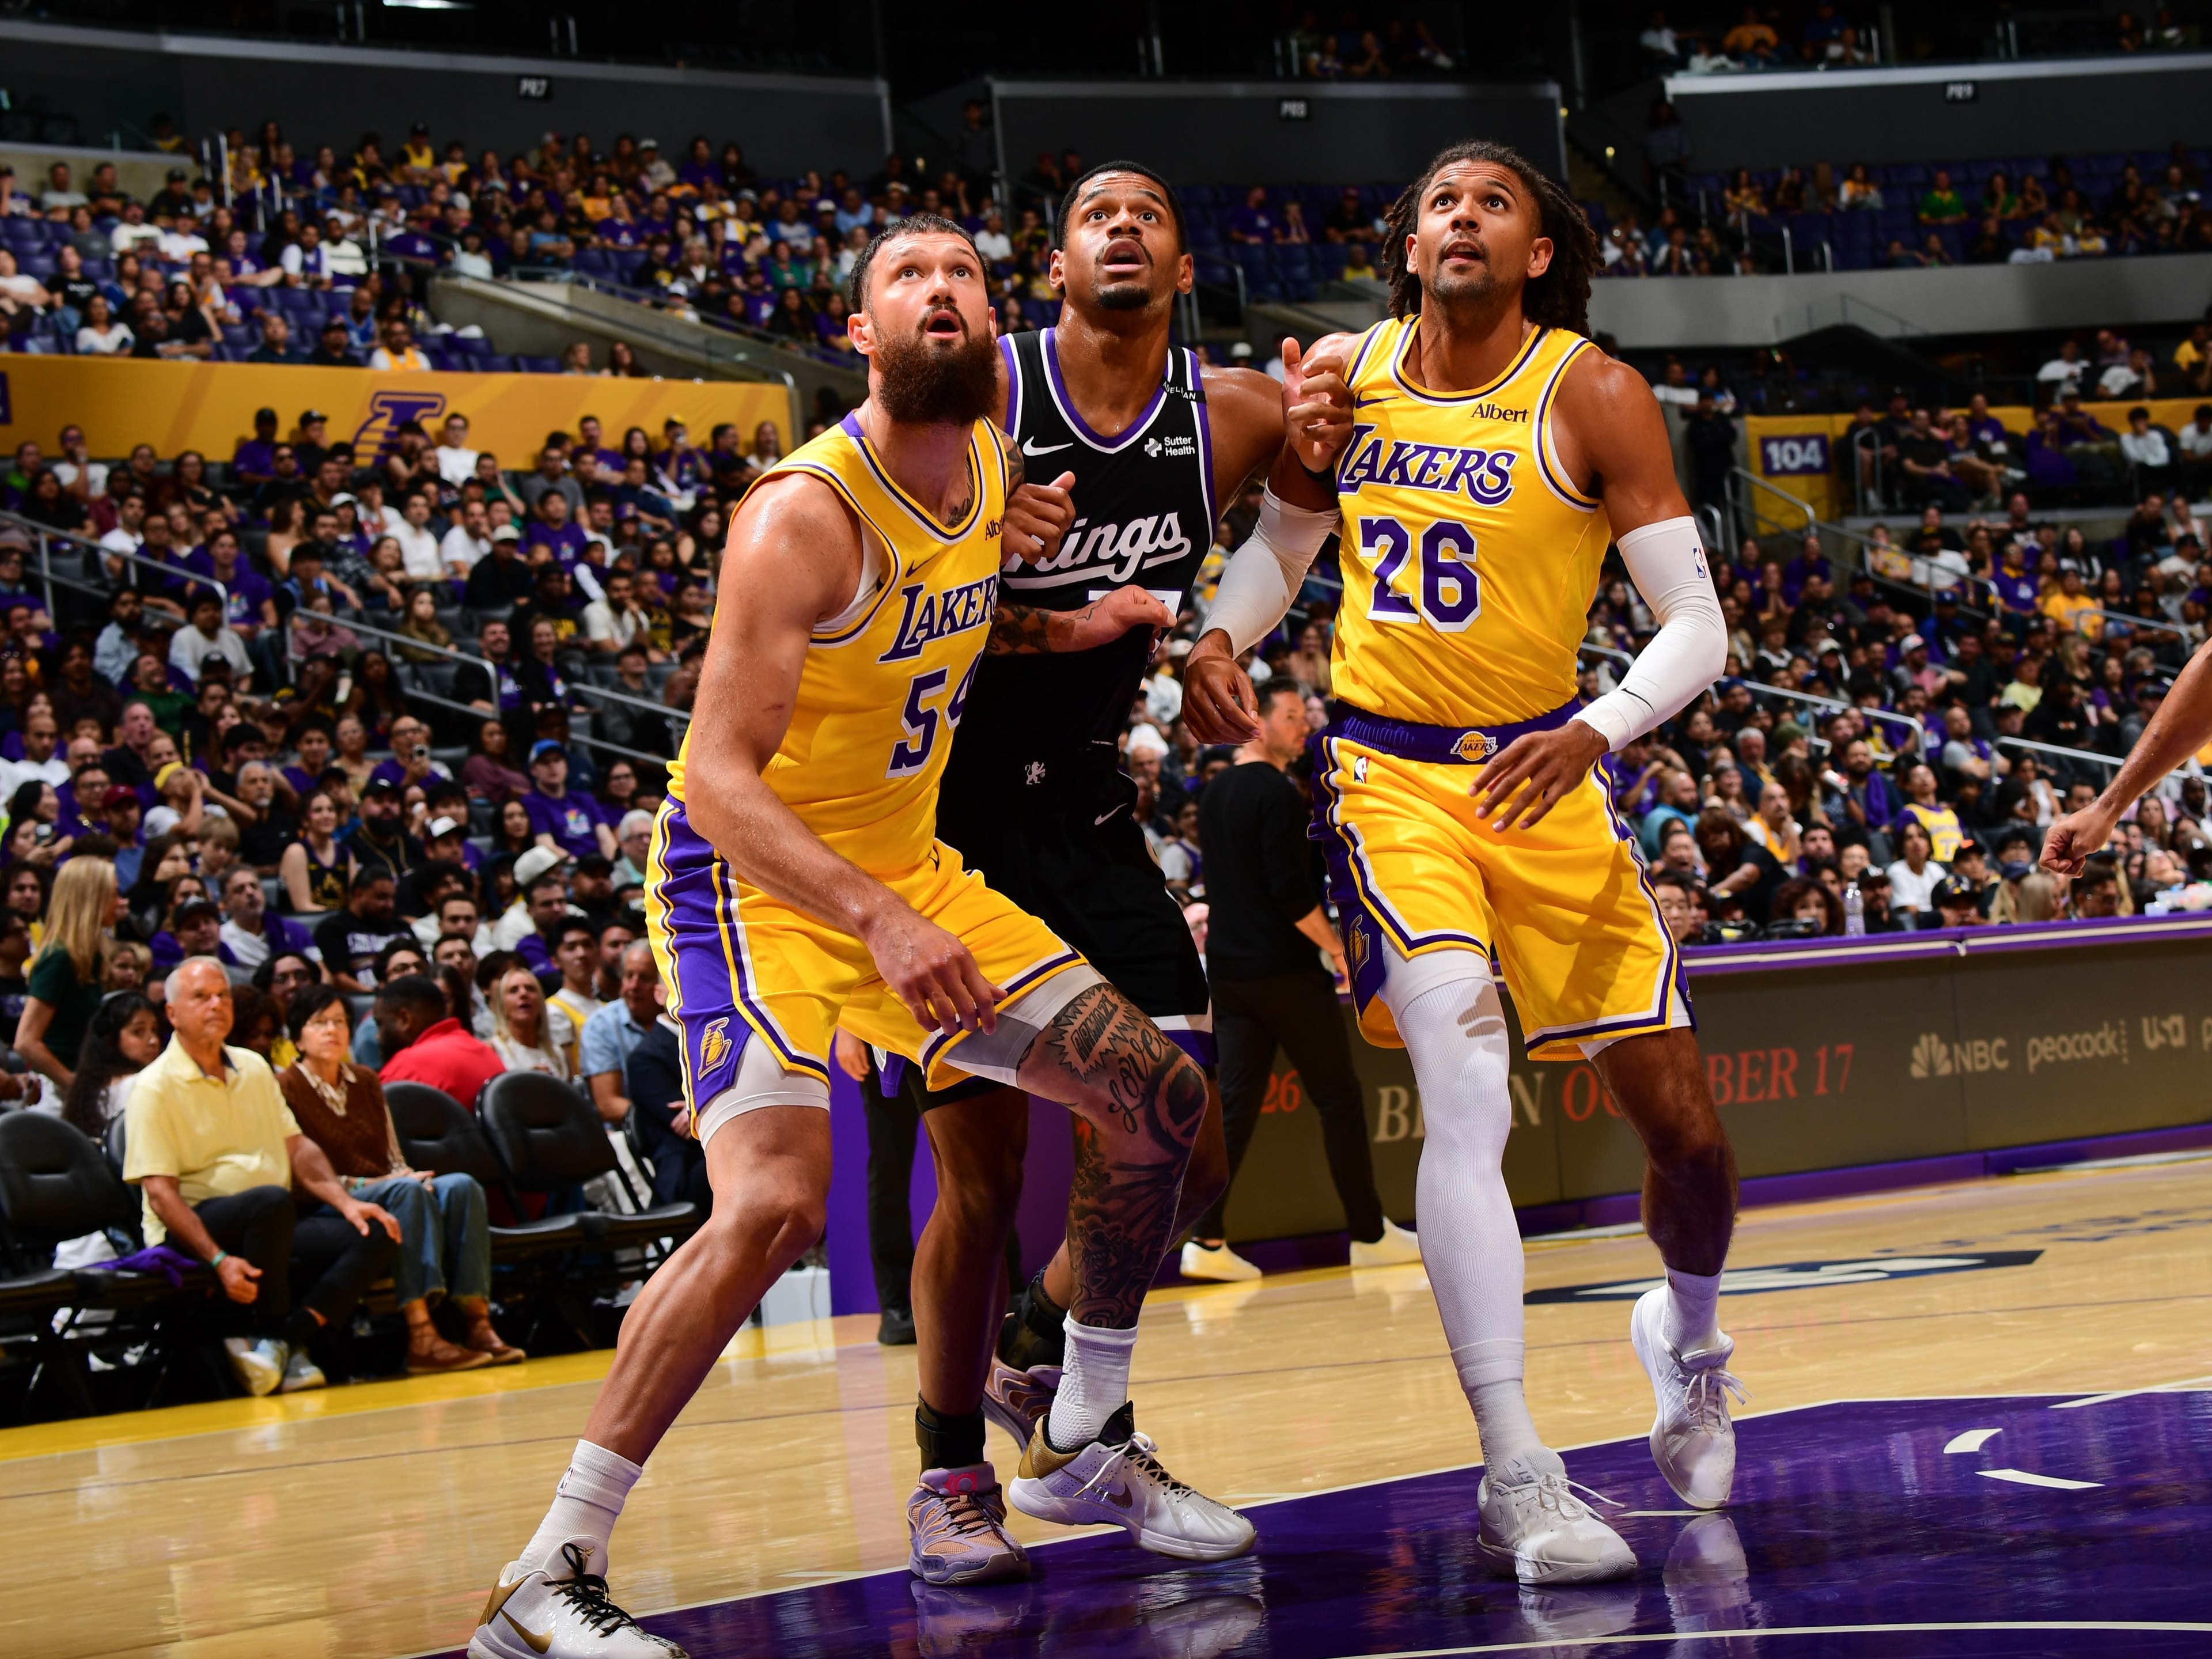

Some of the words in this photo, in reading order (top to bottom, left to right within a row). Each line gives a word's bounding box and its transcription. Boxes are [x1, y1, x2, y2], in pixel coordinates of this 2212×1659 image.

[1471, 403, 1529, 423] Albert
[1164, 436, 1192, 446] Sutter
[1165, 445, 1195, 456] Health
[1336, 422, 1520, 507] LAKERS
[1766, 438, 1825, 471] 104
[1001, 511, 1192, 590] ings
[1358, 516, 1482, 632] 26
[875, 570, 1000, 665] LAKER
[1814, 1043, 1854, 1096] 17
[1953, 1037, 2009, 1074] NBC
[2026, 1021, 2119, 1075] peacock
